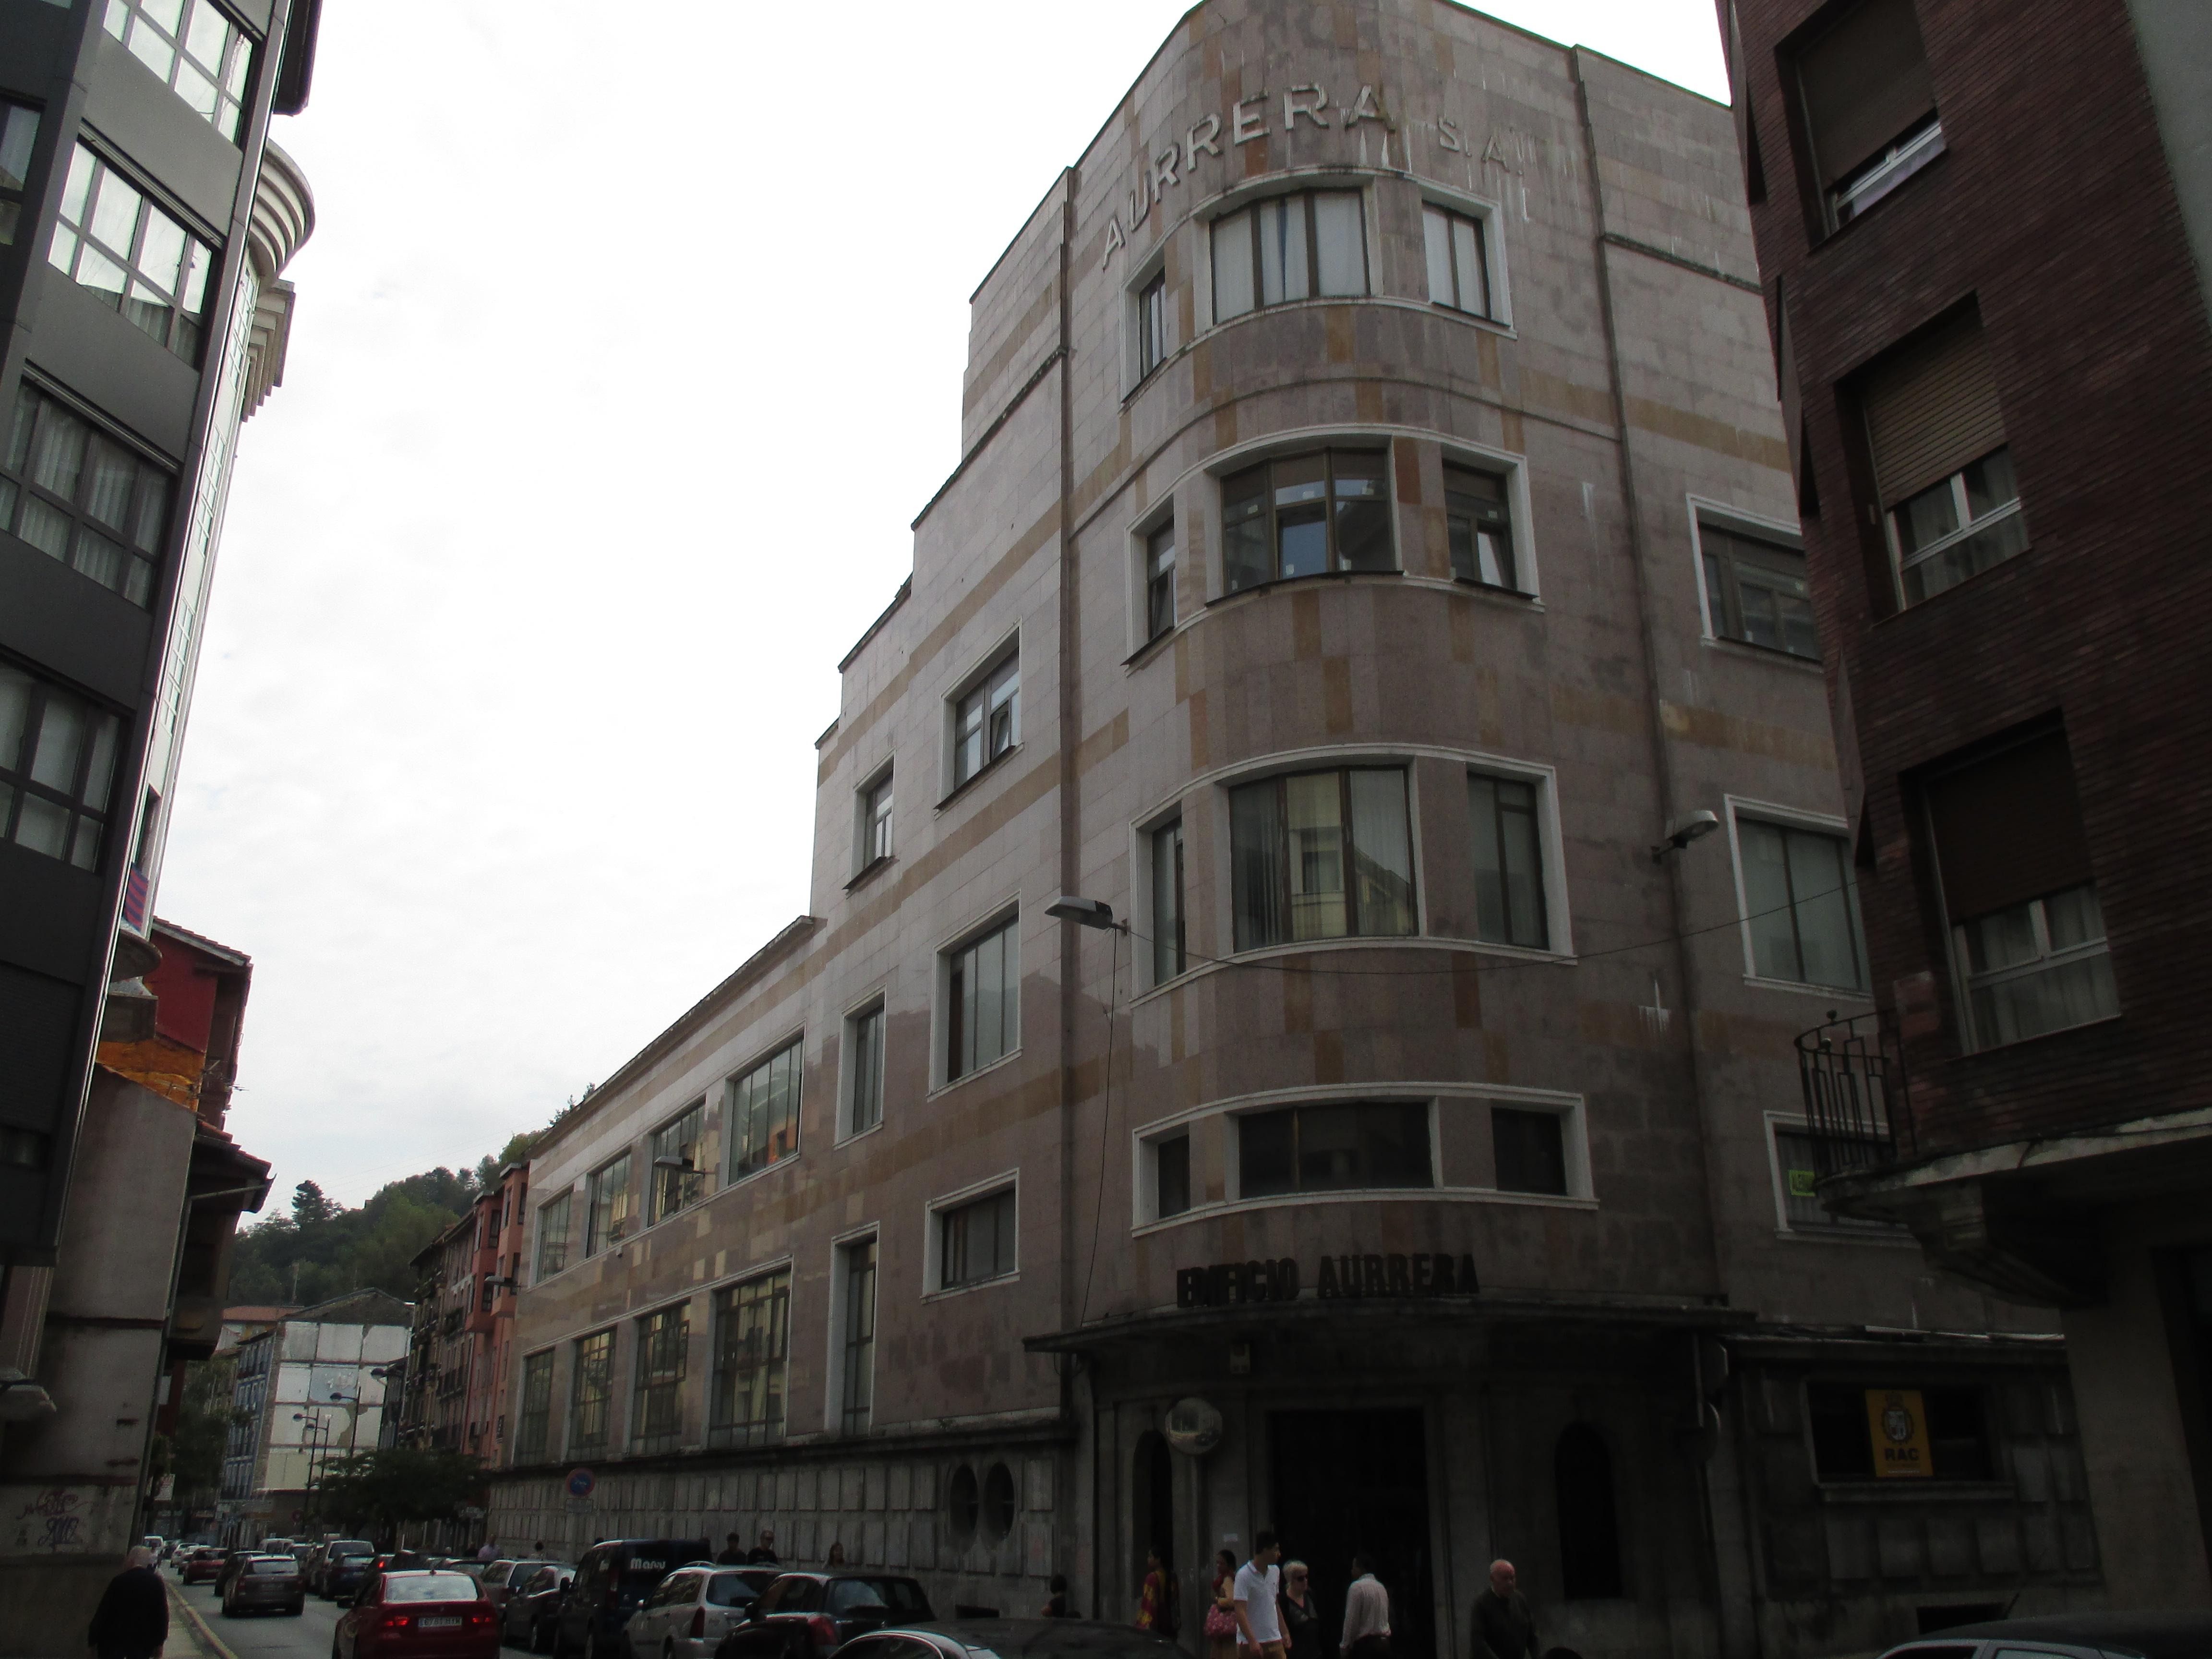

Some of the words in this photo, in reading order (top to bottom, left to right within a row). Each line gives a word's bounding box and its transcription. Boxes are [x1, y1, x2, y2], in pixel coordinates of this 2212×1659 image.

[1103, 84, 1396, 272] AURRERA
[1177, 1257, 1299, 1308] EDIFICIO
[1316, 1253, 1479, 1300] AURRERA
